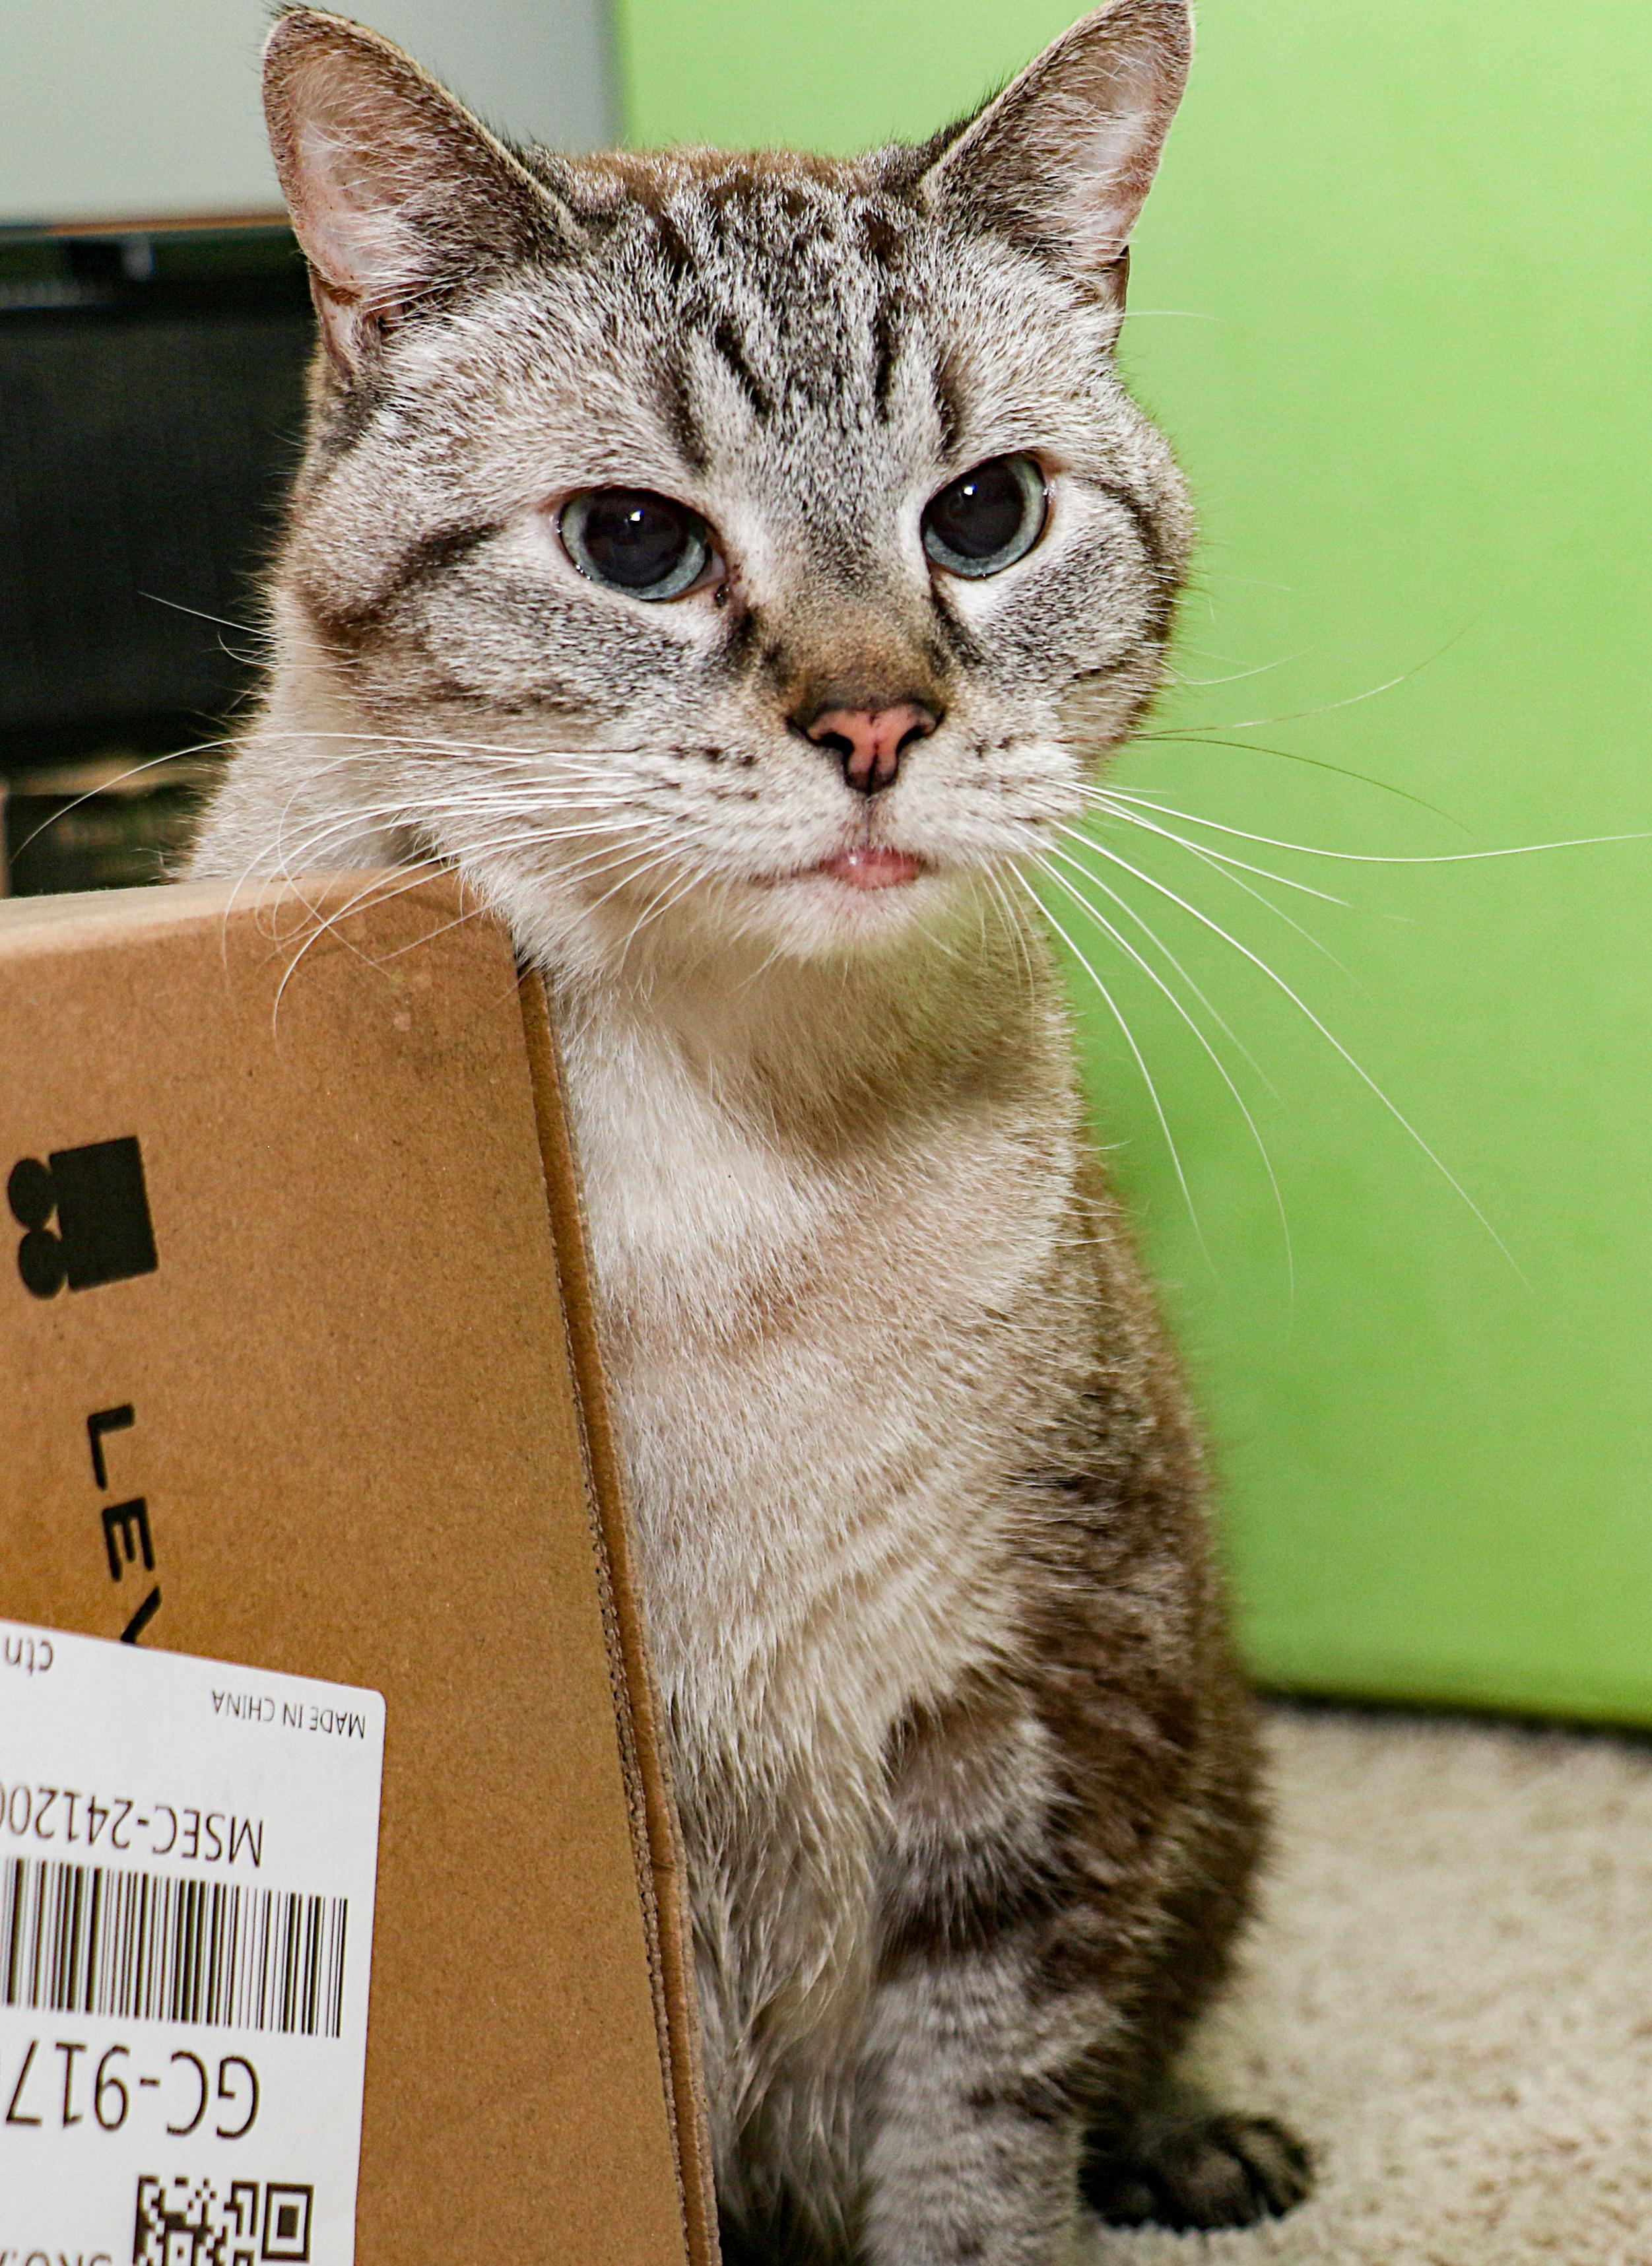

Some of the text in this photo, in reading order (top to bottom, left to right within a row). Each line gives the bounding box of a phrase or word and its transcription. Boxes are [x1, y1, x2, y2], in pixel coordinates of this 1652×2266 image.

[211, 1689, 366, 1741] MADE IN CHINA
[0, 1783, 264, 1869] MSEC-24120
[5, 2040, 261, 2141] GC-917
